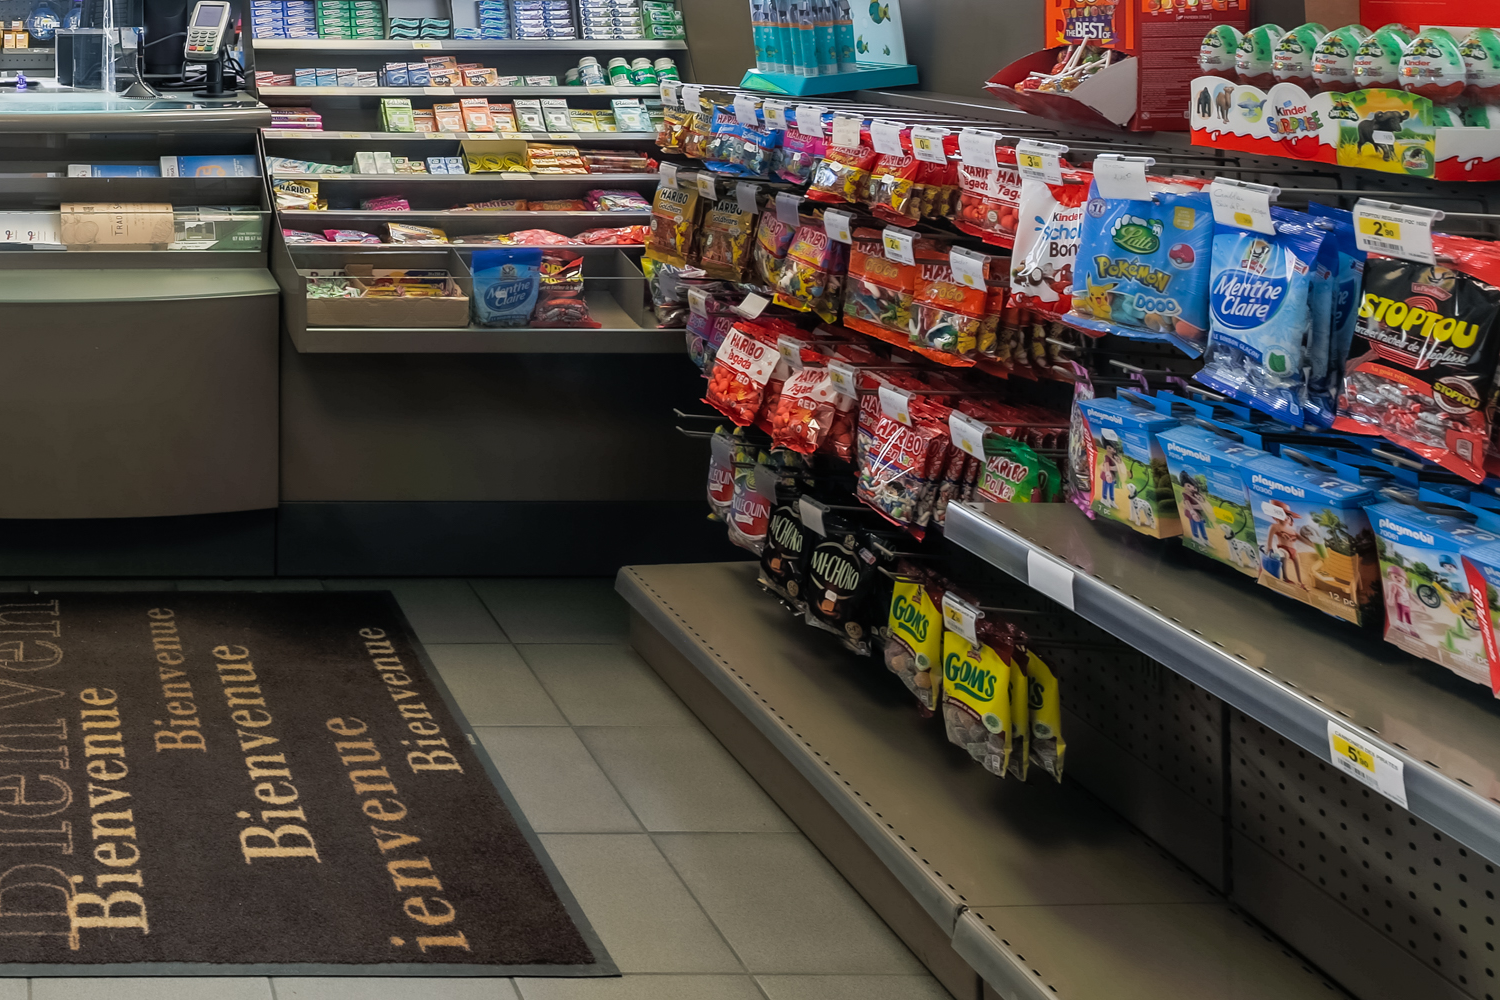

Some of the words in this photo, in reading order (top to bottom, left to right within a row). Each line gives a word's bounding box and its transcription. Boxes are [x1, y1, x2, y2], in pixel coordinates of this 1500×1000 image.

[1066, 29, 1076, 37] THE
[1075, 22, 1105, 39] BEST
[1103, 31, 1111, 39] OF
[1267, 110, 1325, 136] SURPRISE
[279, 184, 311, 194] HARIBO
[659, 188, 689, 205] HARIBO
[712, 200, 743, 216] HARIBO
[1213, 274, 1283, 300] Menthe
[1220, 295, 1270, 318] Claire
[1358, 293, 1479, 349] STOPTOU
[729, 332, 765, 362] HARIBO
[735, 374, 749, 386] RED
[798, 398, 817, 411] RED
[1433, 381, 1480, 409] STOPTOU
[1087, 408, 1123, 426] playmobil
[876, 415, 924, 456] HARIBO
[1167, 442, 1211, 464] playmobil
[987, 455, 1029, 484] HARIBO
[1252, 474, 1305, 499] playmobil
[1378, 518, 1434, 546] playmobil
[810, 550, 860, 592] MI-CHOKO
[1328, 591, 1341, 601] 12
[1342, 597, 1355, 607] pc
[892, 594, 930, 641] GOM'S
[147, 606, 207, 753] Bienvenue
[944, 652, 997, 698] GOM'S
[359, 626, 465, 775] Bienvenue
[212, 643, 322, 865] Bienvenue
[68, 686, 149, 937] Bienvenue
